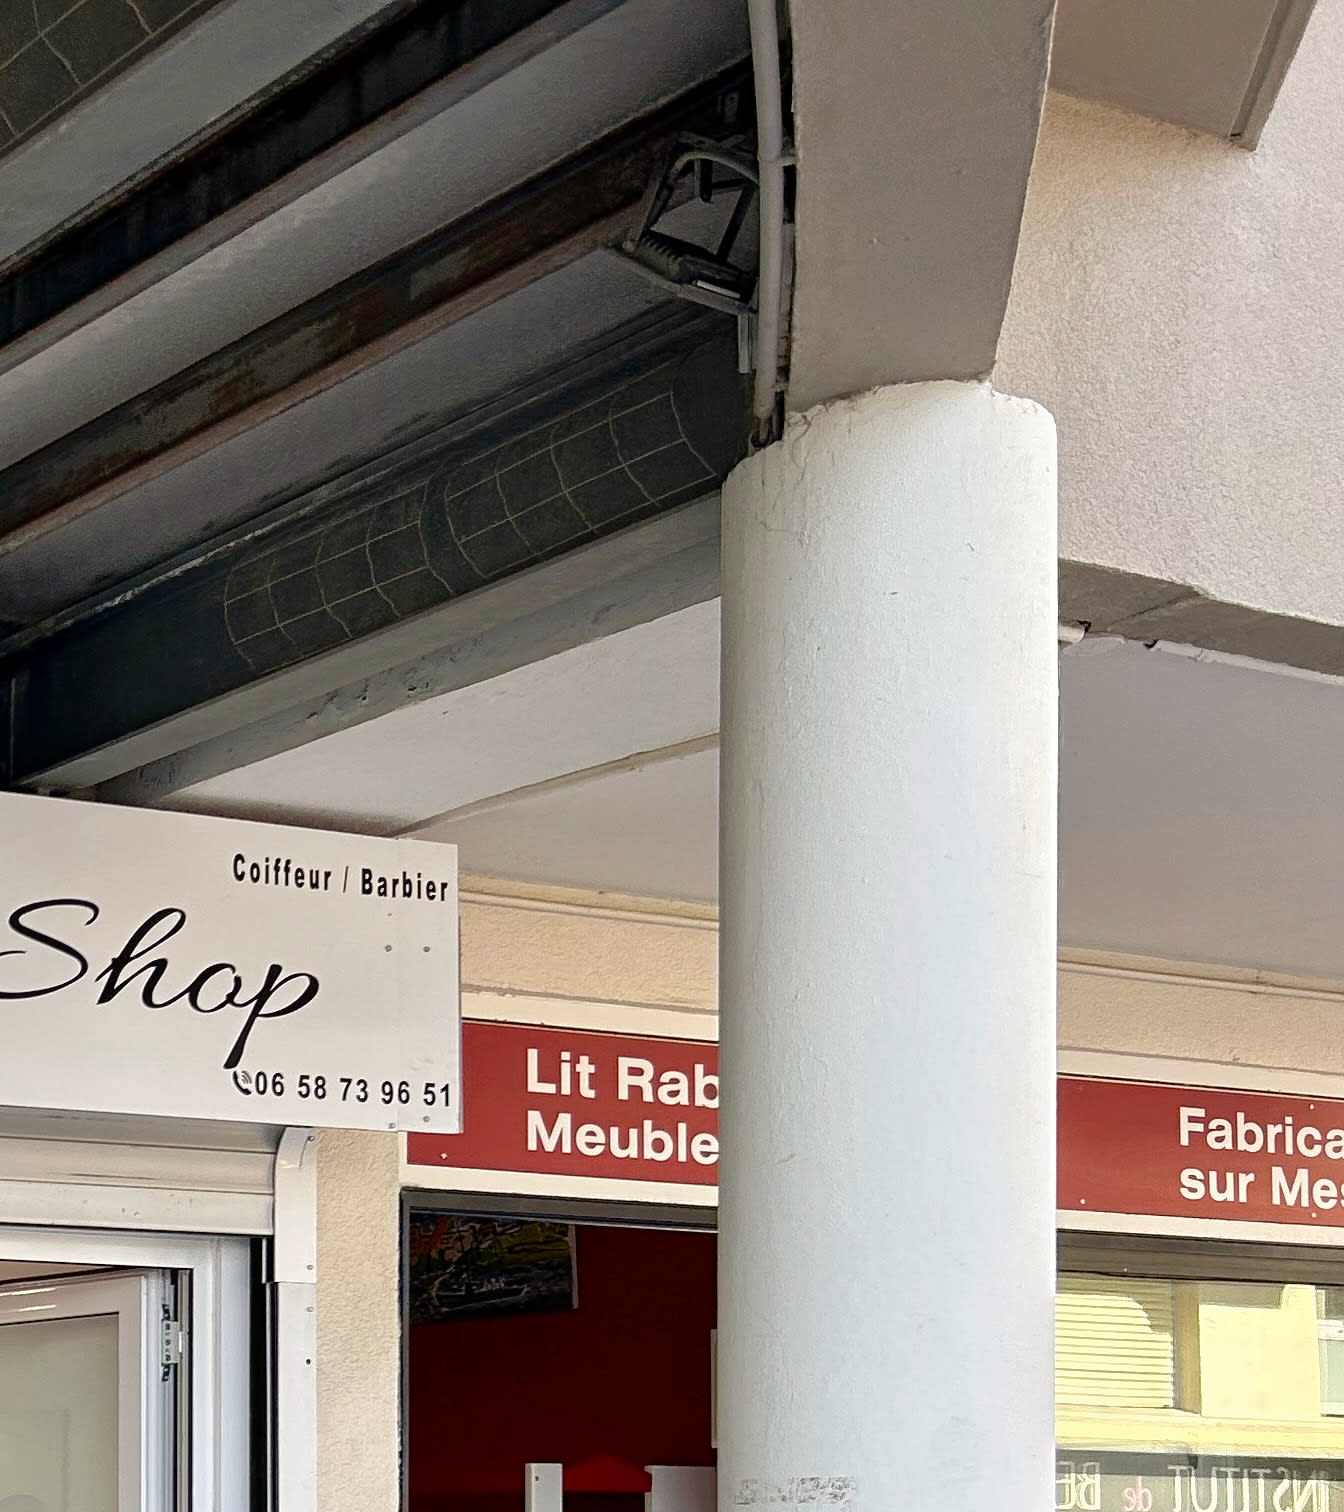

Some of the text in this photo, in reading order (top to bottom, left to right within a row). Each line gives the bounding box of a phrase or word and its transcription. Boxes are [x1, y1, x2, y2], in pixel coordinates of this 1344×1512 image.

[233, 853, 448, 902] Coiffeur / Barbier
[255, 1071, 450, 1107] 06 58 73 96 51
[526, 1048, 596, 1099] Lit
[1179, 1166, 1344, 1210] sur Me
